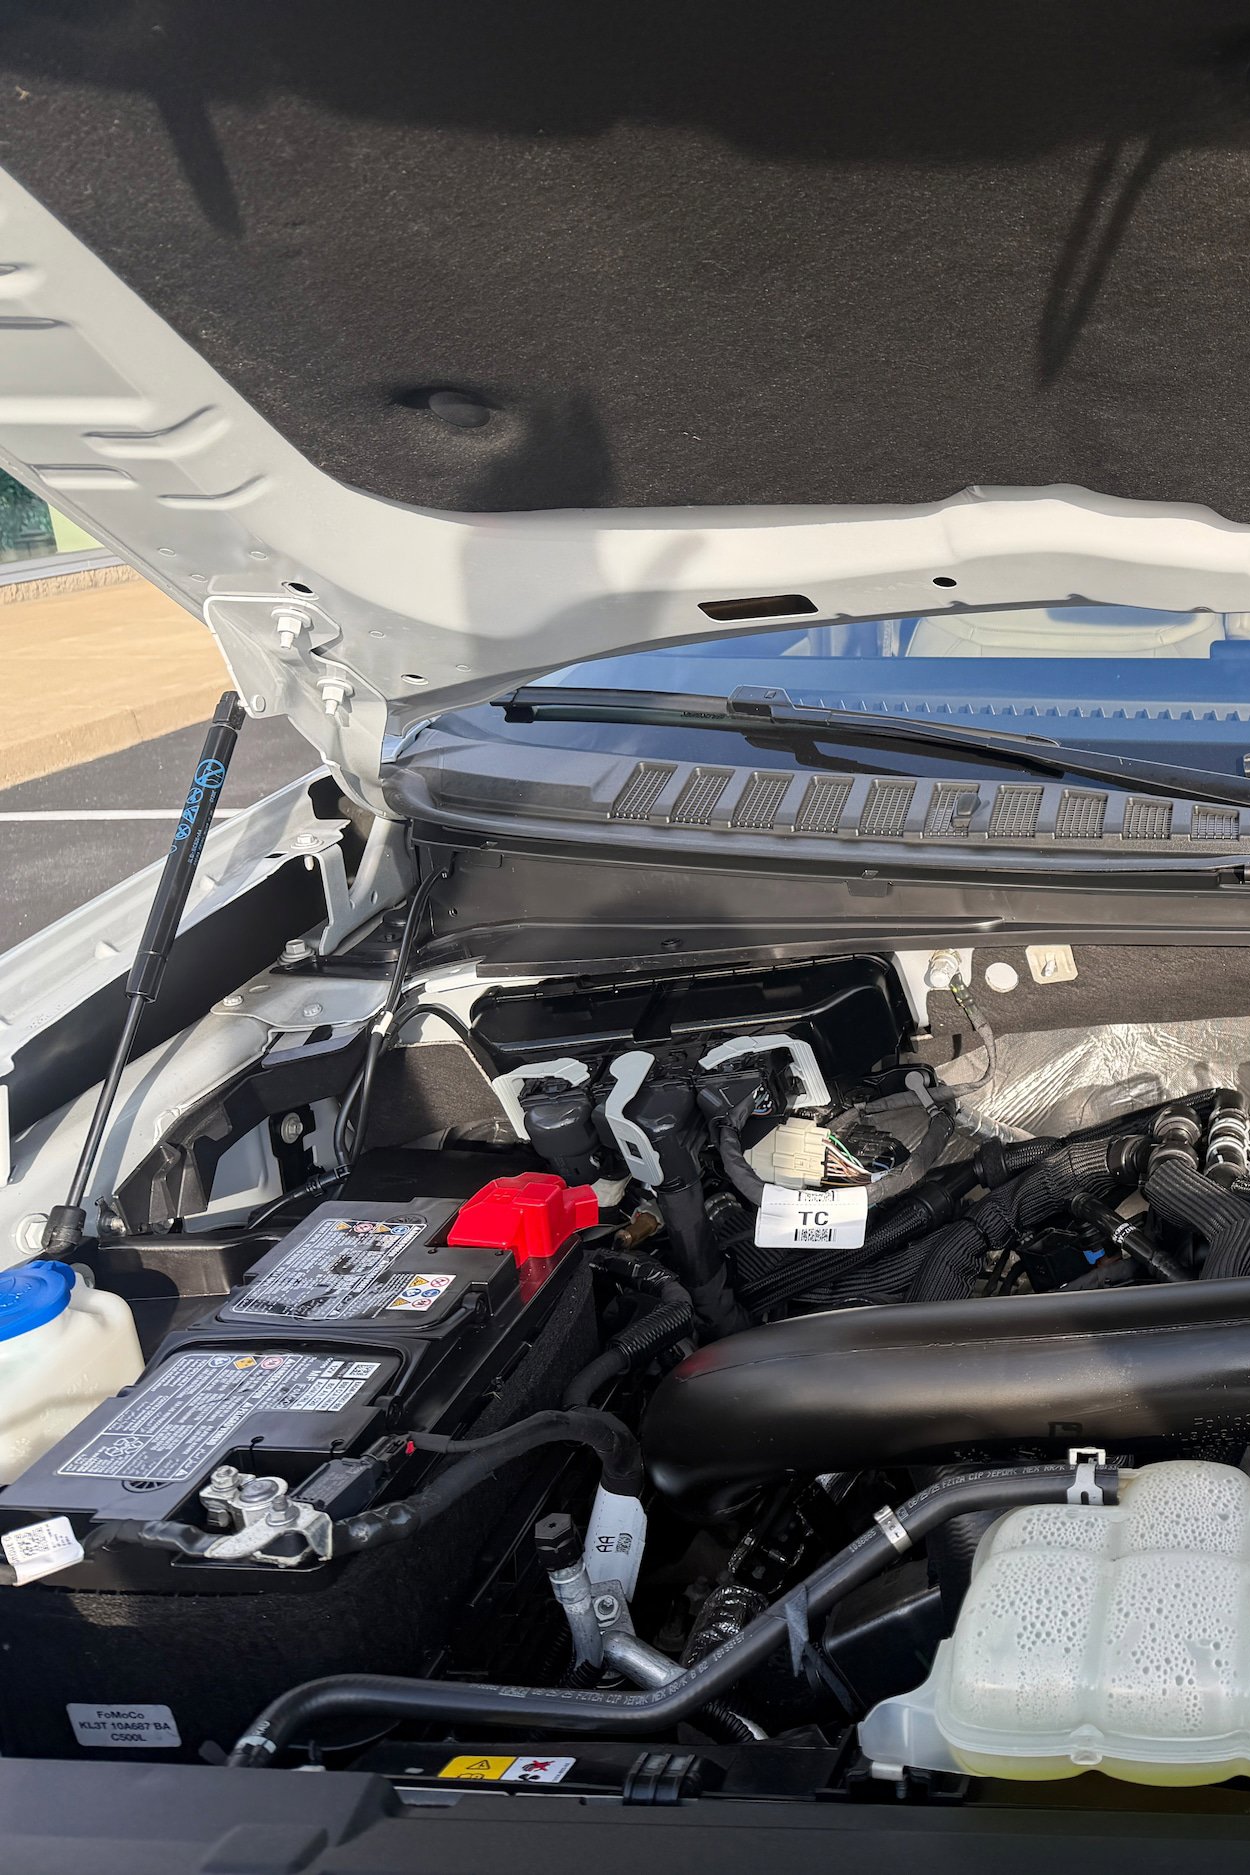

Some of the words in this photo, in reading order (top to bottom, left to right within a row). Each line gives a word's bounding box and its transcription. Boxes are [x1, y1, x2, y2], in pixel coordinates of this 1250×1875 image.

[798, 1211, 829, 1226] TC
[595, 1535, 616, 1553] AA
[96, 1710, 145, 1719] FoMoCo
[78, 1721, 108, 1730] KL3T
[111, 1721, 151, 1730] 10A687
[153, 1722, 171, 1730] BA
